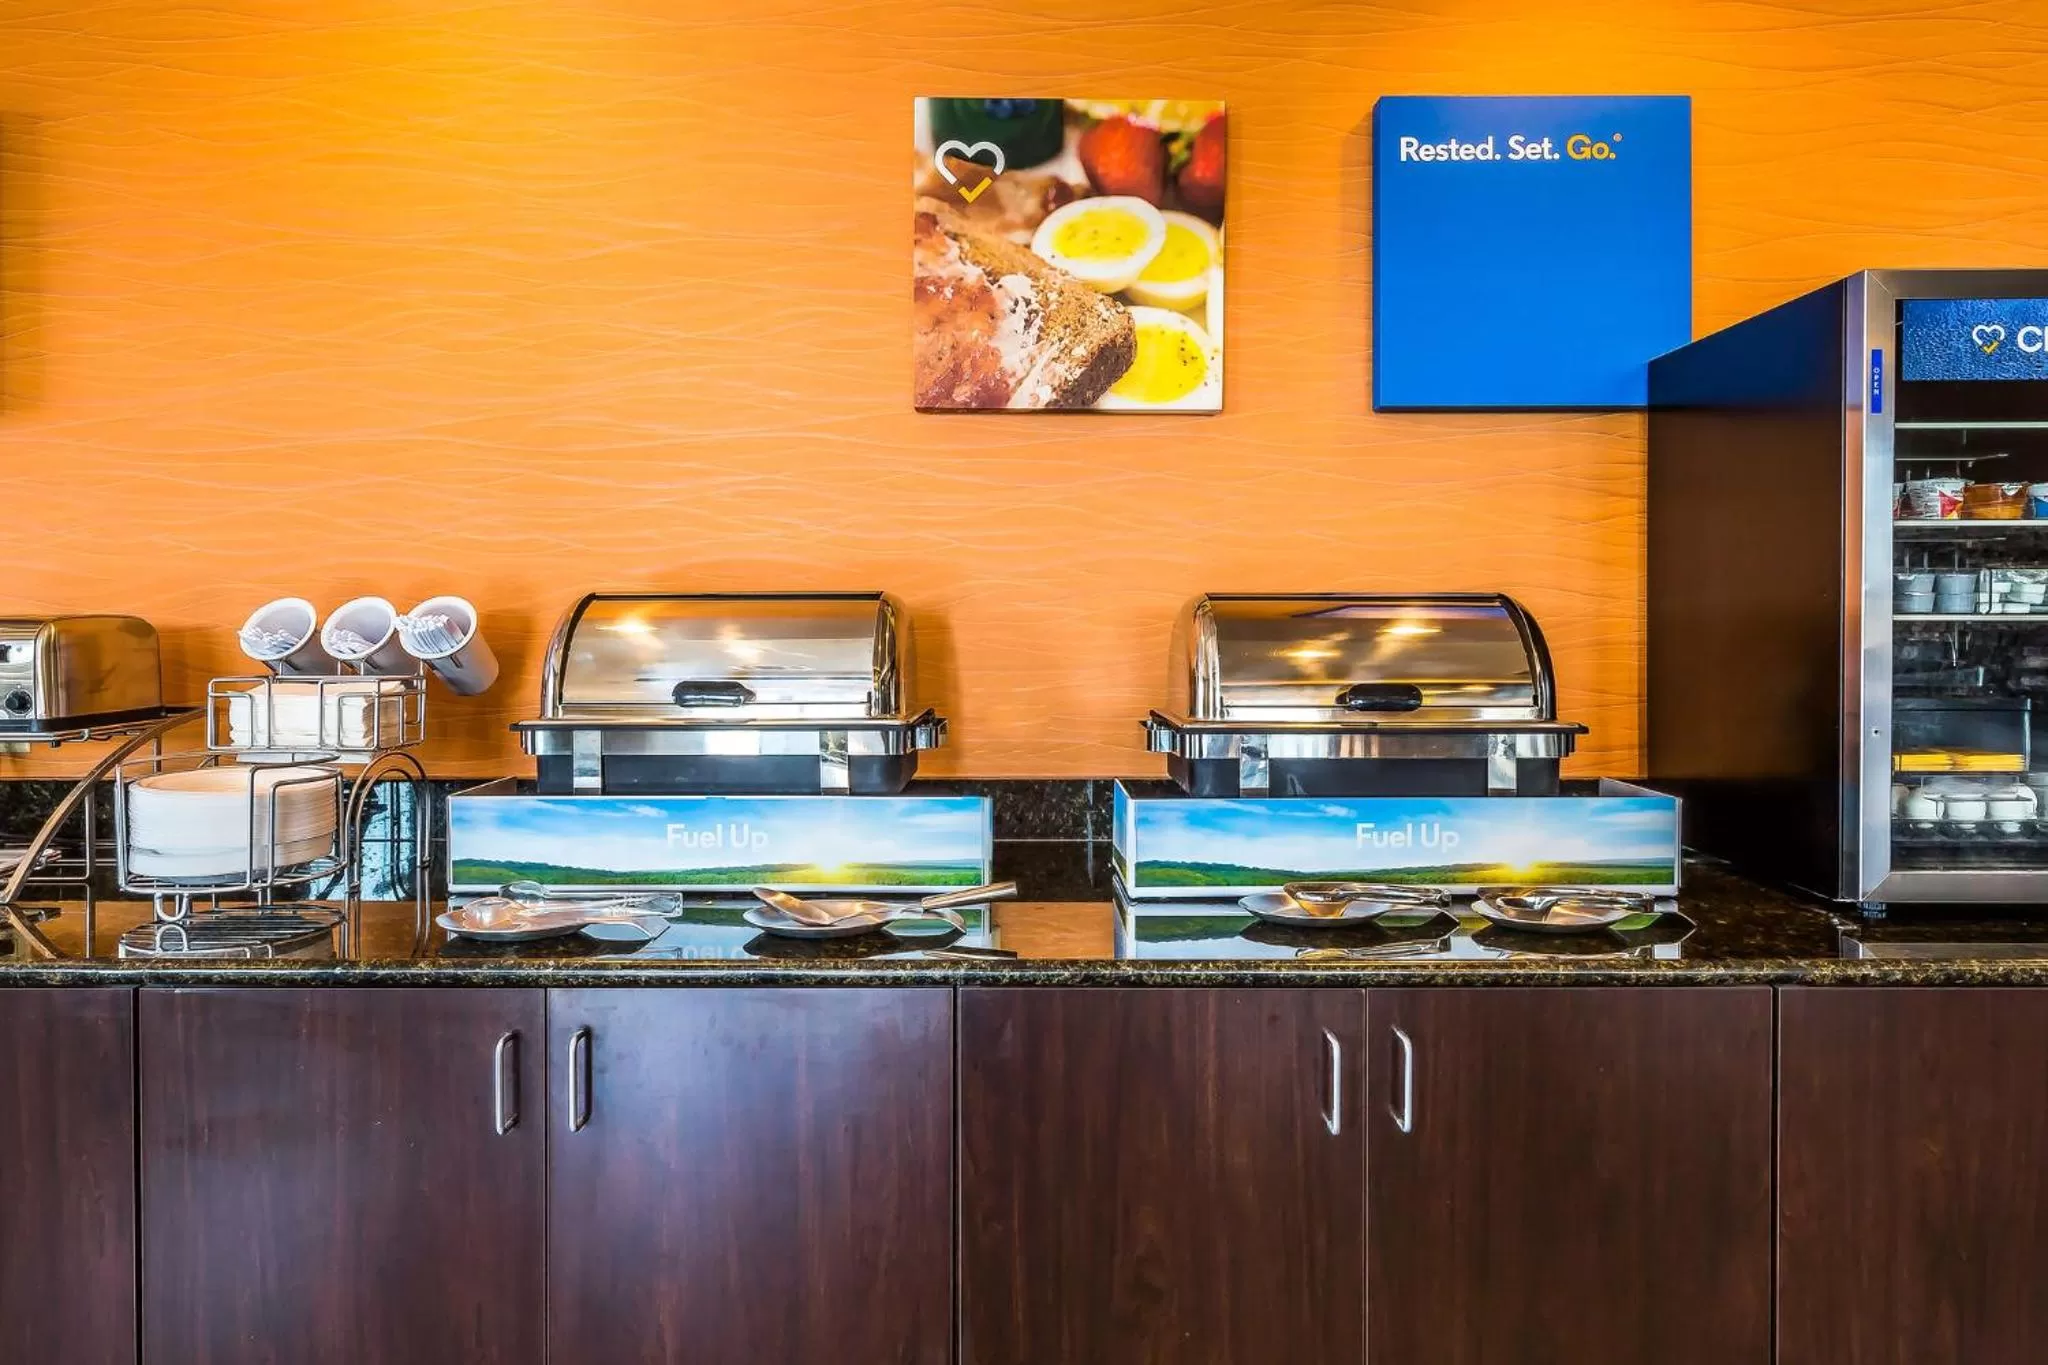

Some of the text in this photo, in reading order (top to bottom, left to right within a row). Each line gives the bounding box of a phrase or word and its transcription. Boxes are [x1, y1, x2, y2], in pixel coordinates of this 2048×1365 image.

[1399, 135, 1501, 161] Rested.
[1507, 134, 1560, 160] Set.
[666, 823, 769, 852] Fuel Up
[1356, 822, 1460, 853] Fuel Up
